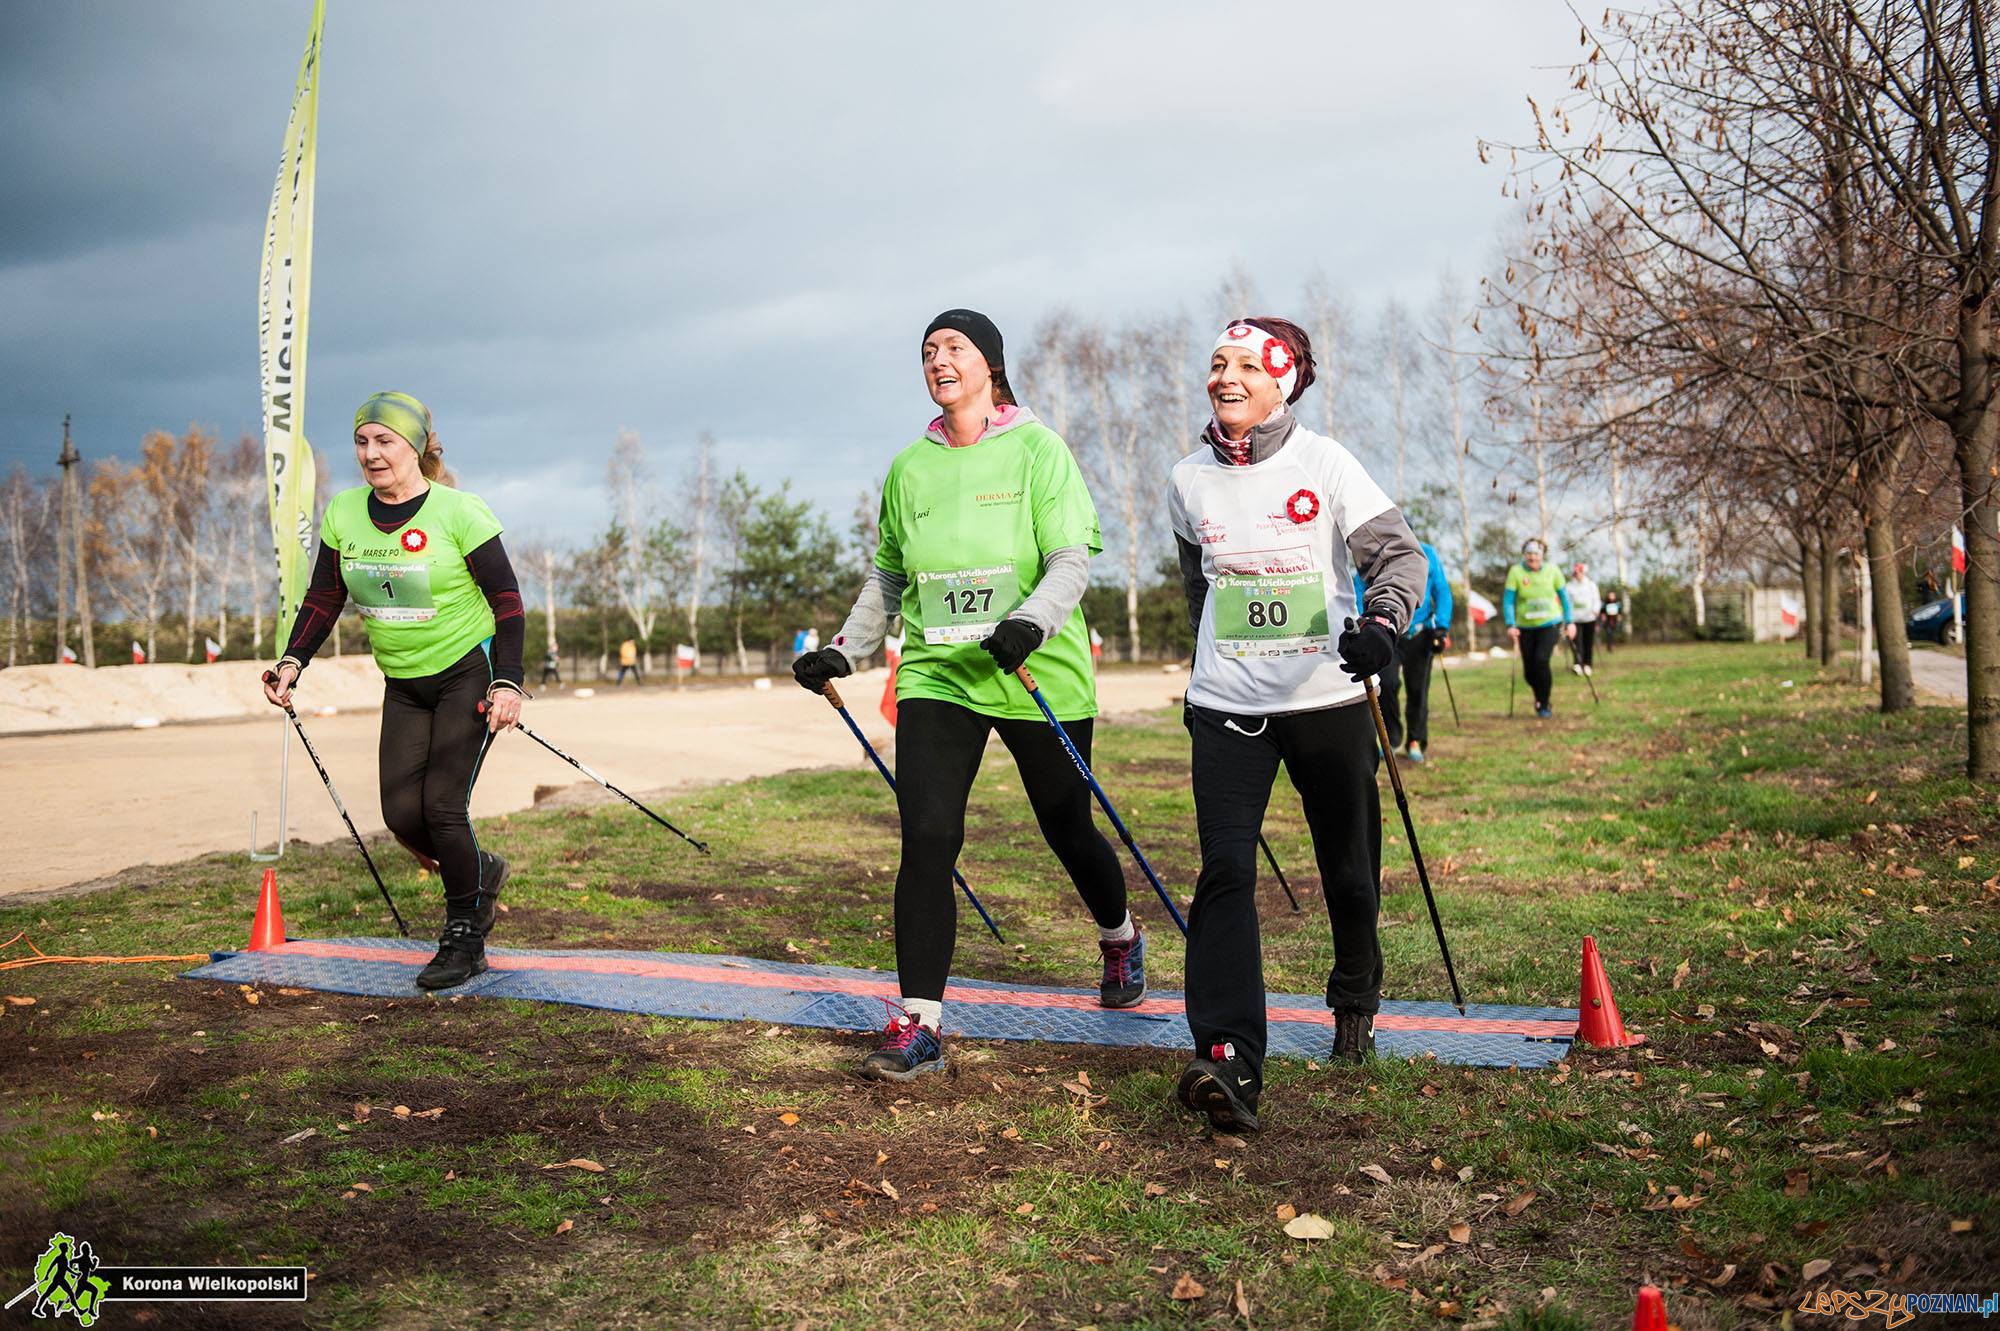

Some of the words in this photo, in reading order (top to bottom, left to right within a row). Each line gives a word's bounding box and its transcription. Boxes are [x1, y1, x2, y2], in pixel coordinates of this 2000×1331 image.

[362, 549, 387, 557] MARSZ
[388, 548, 399, 556] PO
[928, 572, 957, 581] Korona
[957, 565, 1013, 579] Wielkopolski
[1264, 564, 1308, 574] WALKING
[381, 580, 395, 600] 1
[1228, 578, 1257, 587] Korona
[944, 588, 995, 615] 127
[1247, 600, 1289, 628] 80
